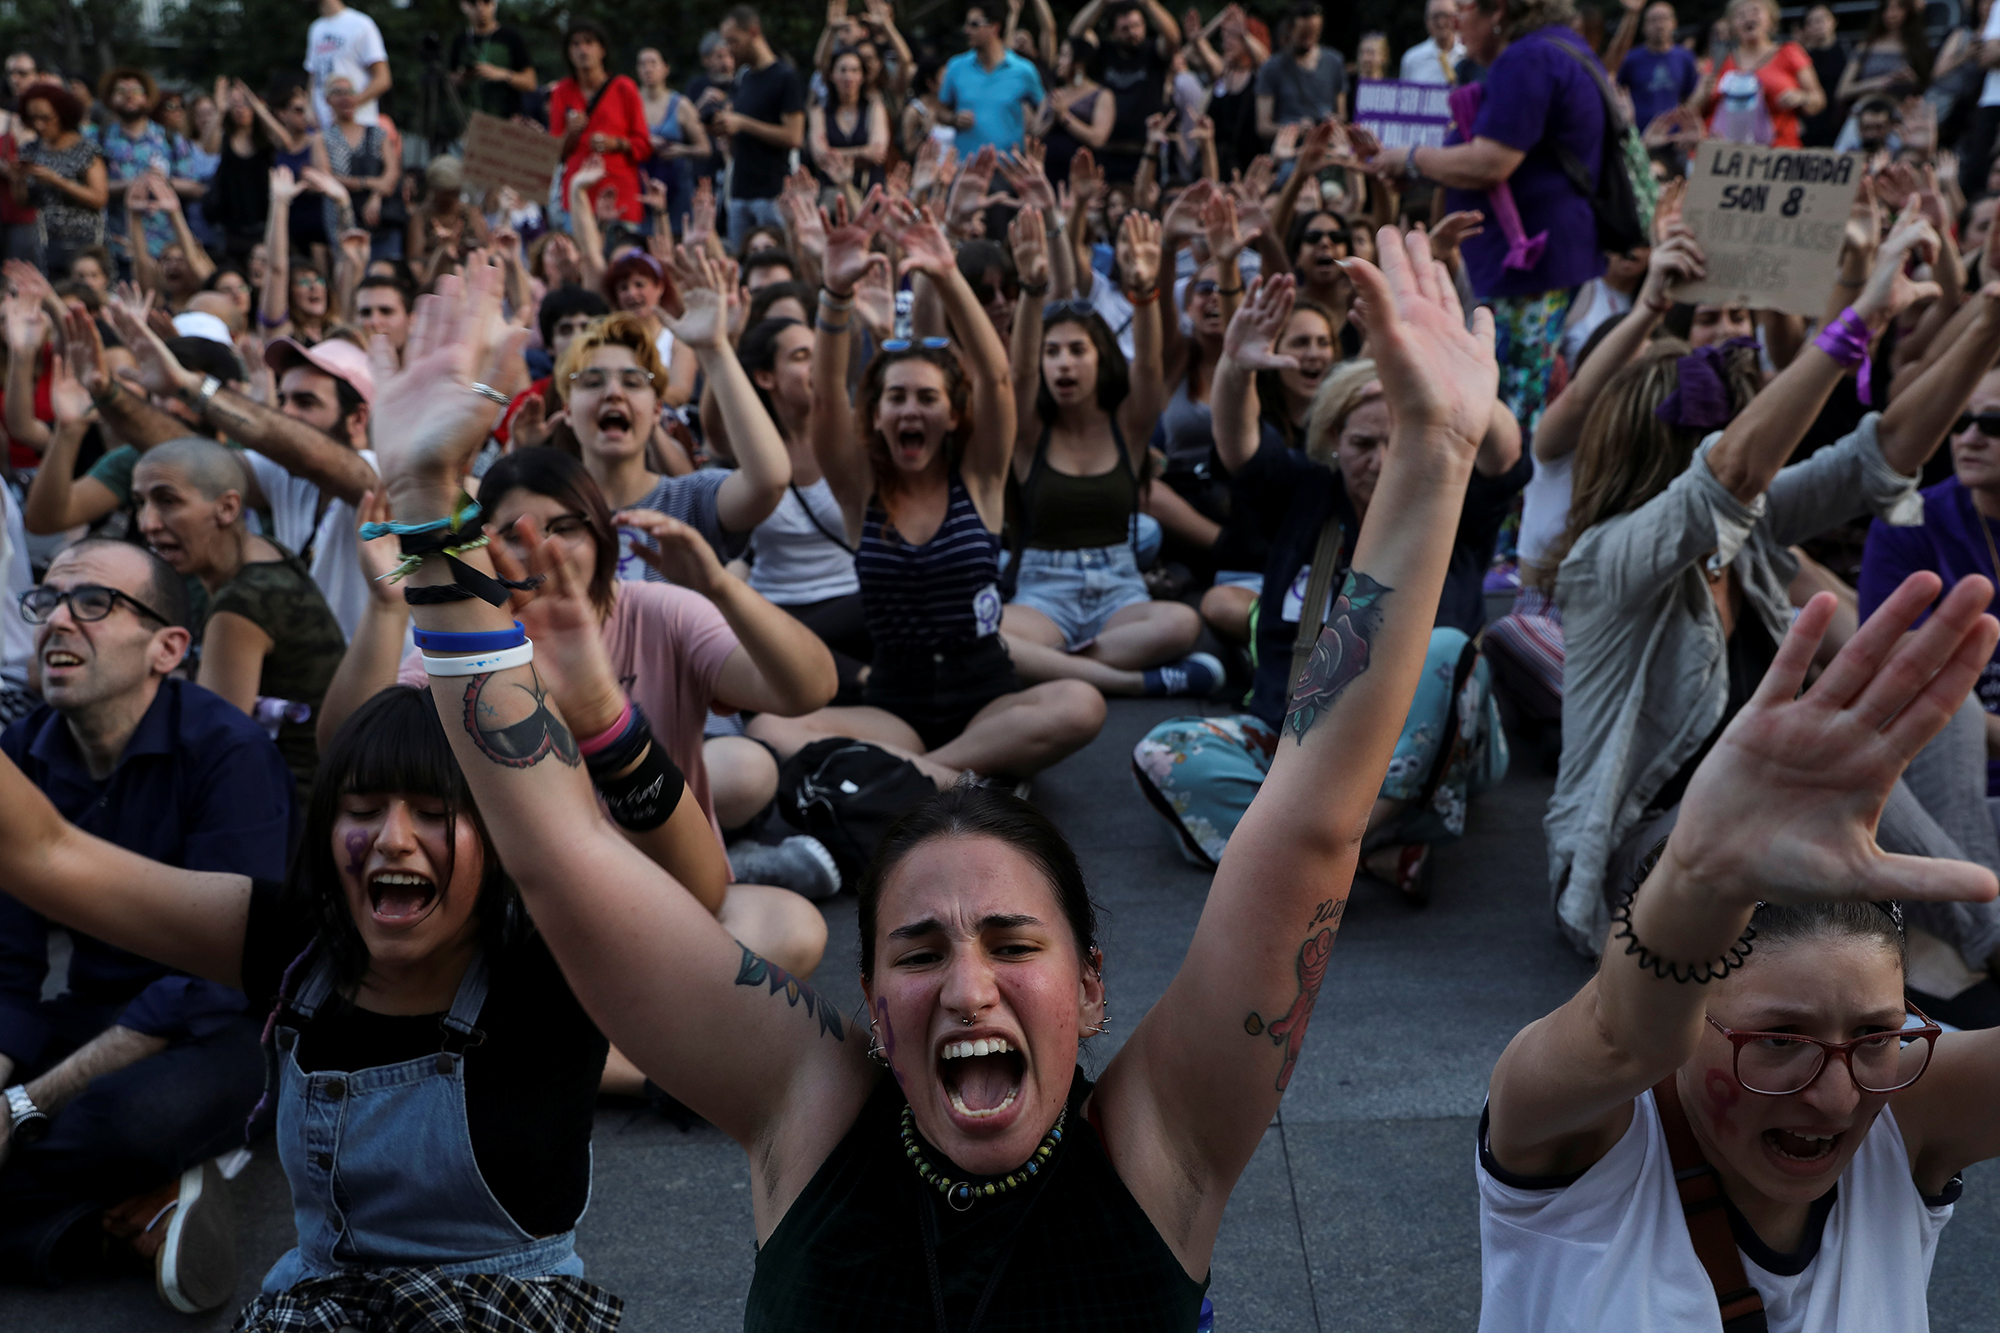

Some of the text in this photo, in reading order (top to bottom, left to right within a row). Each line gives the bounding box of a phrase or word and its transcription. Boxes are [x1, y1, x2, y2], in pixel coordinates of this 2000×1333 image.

[1711, 150, 1856, 186] LA MANADA
[1718, 184, 1770, 213] SON
